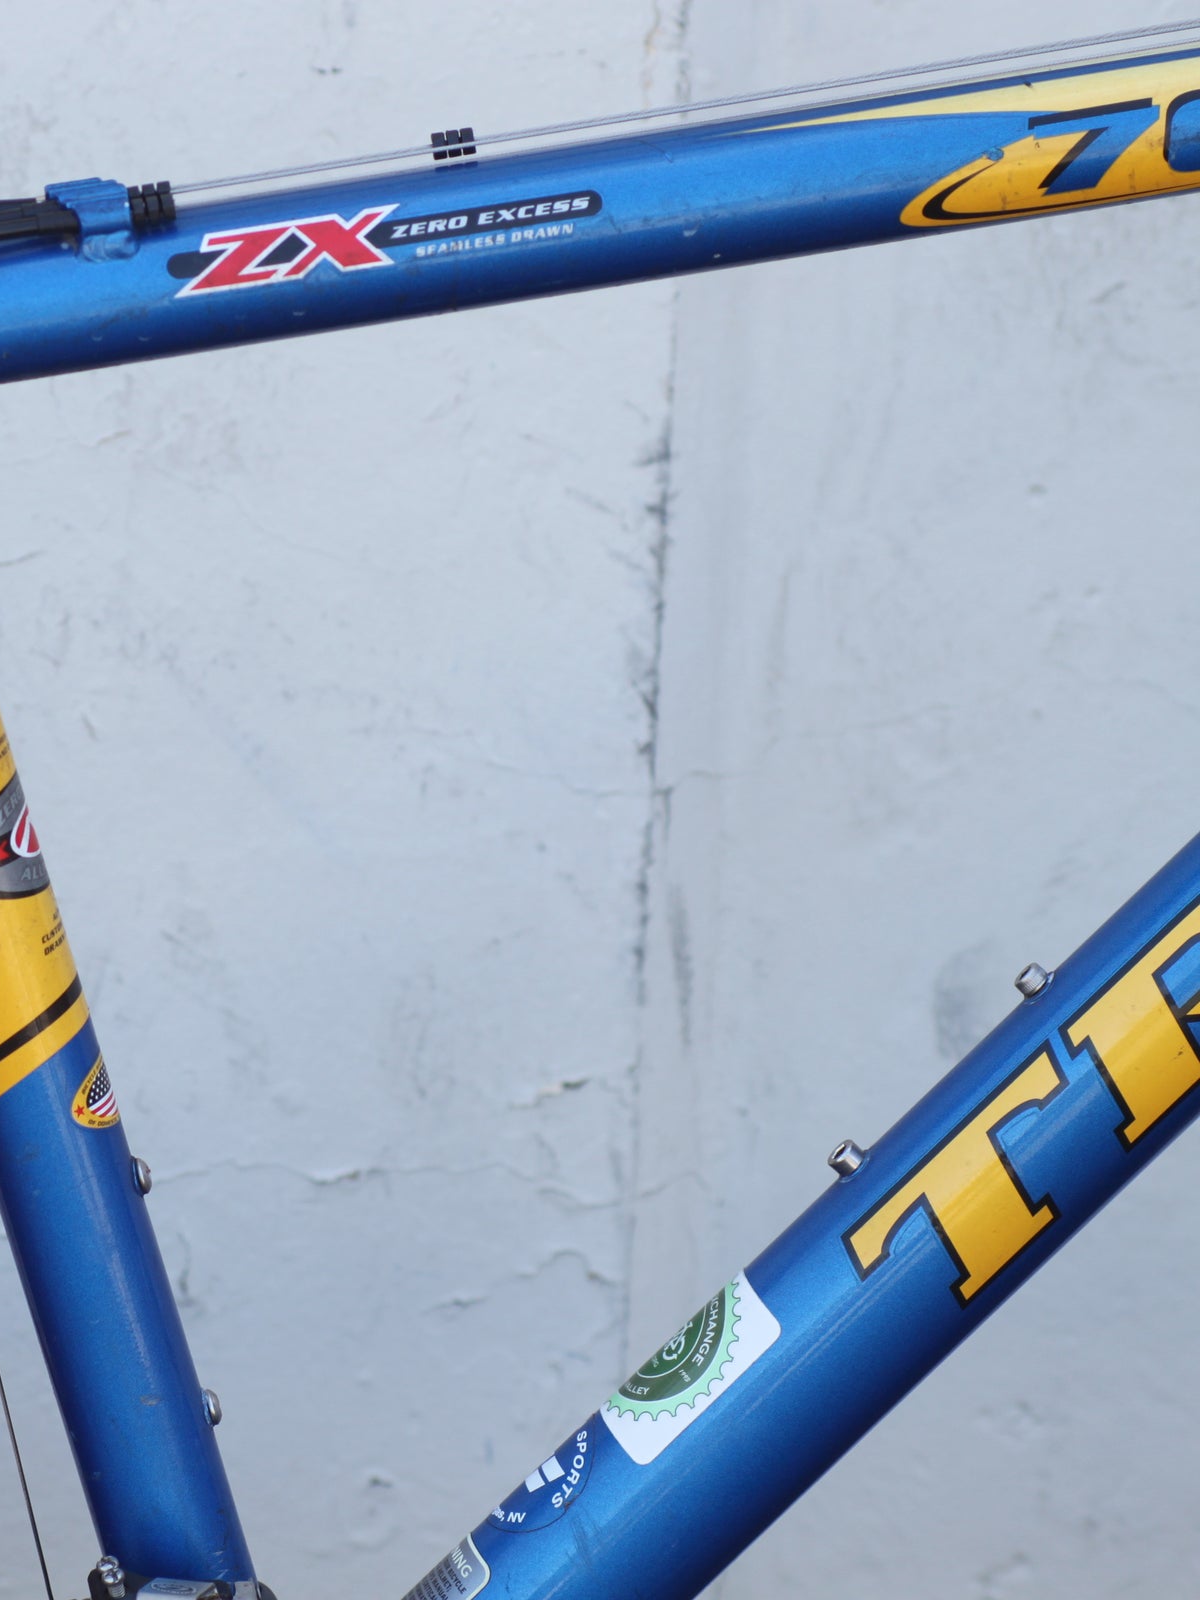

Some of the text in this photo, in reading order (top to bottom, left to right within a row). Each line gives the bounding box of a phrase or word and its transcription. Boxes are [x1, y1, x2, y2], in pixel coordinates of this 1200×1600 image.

[390, 196, 591, 239] ZERO EXCESS
[175, 203, 400, 298] ZX
[416, 222, 574, 257] SEAMLESS DRAWN
[551, 1430, 588, 1508] SPORTS
[506, 1511, 527, 1523] NV
